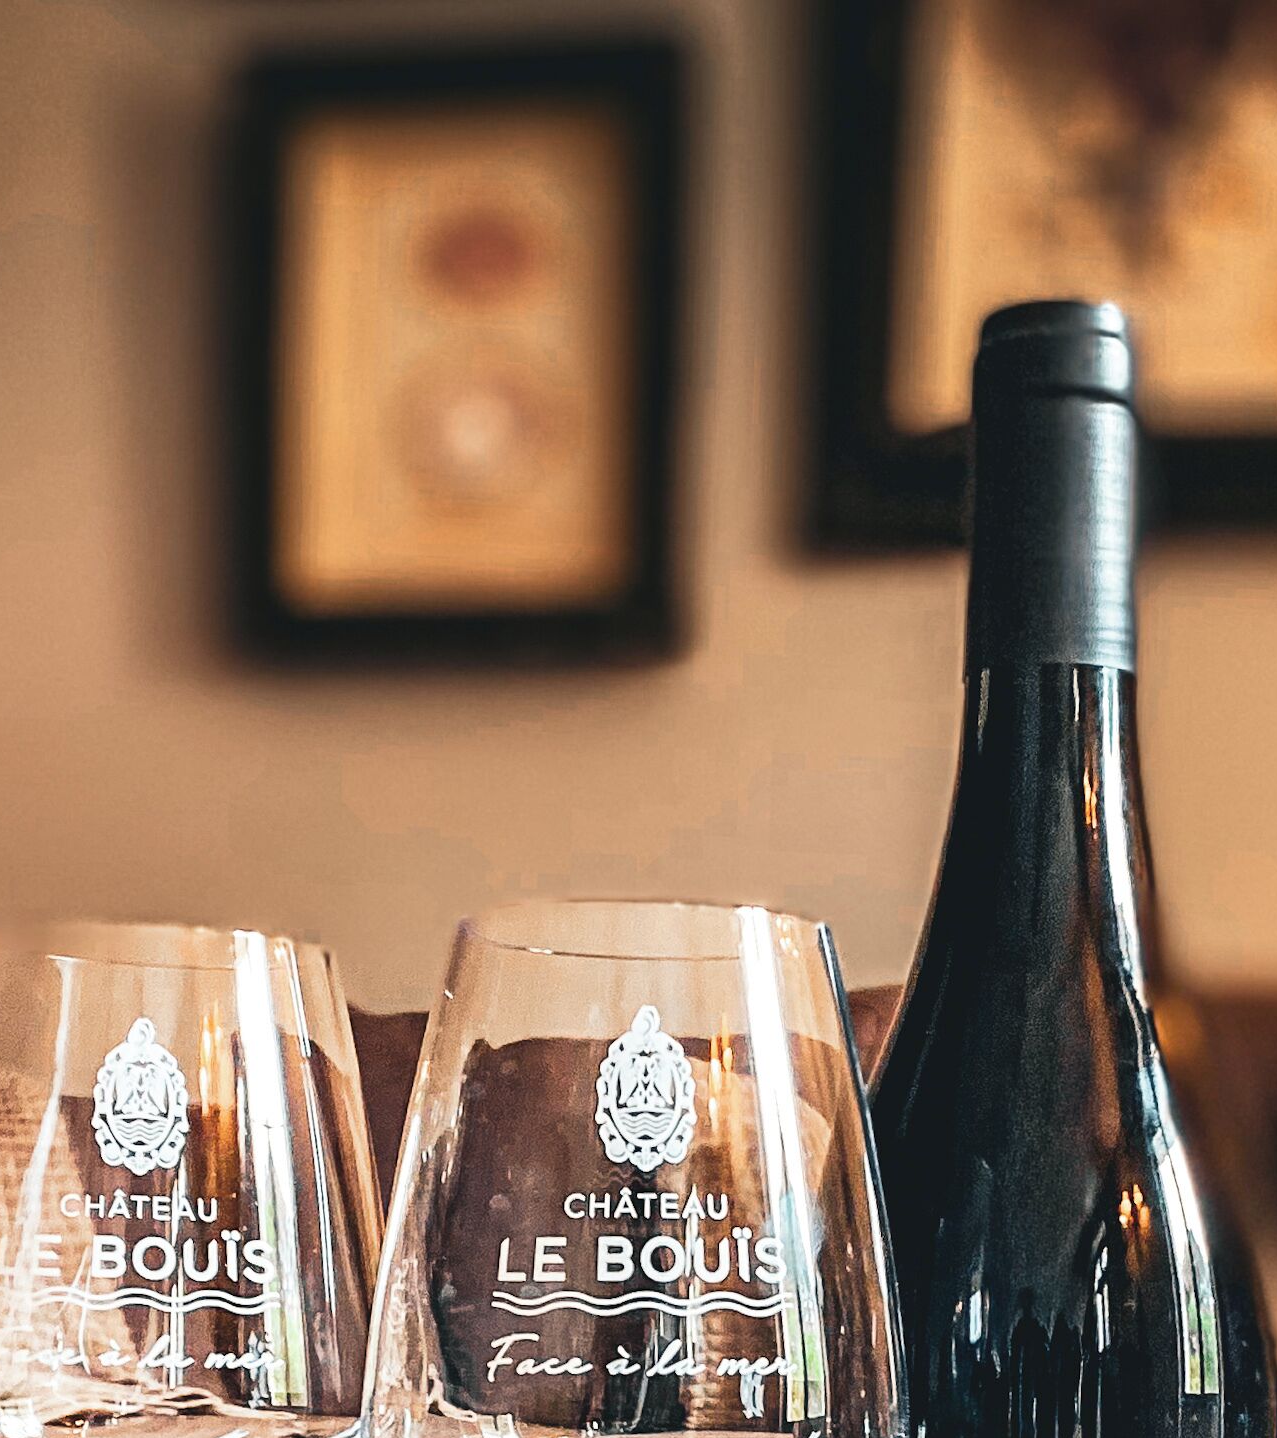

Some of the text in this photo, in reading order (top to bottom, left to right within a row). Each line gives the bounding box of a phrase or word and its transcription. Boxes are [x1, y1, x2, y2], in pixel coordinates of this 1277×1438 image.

[59, 1188, 219, 1222] CHÂTEAU
[563, 1187, 729, 1221] CHÂTEAU
[90, 1229, 279, 1284] BOUÏS
[497, 1226, 788, 1284] LE BOUÏS
[486, 1332, 799, 1383] Face à la mer
